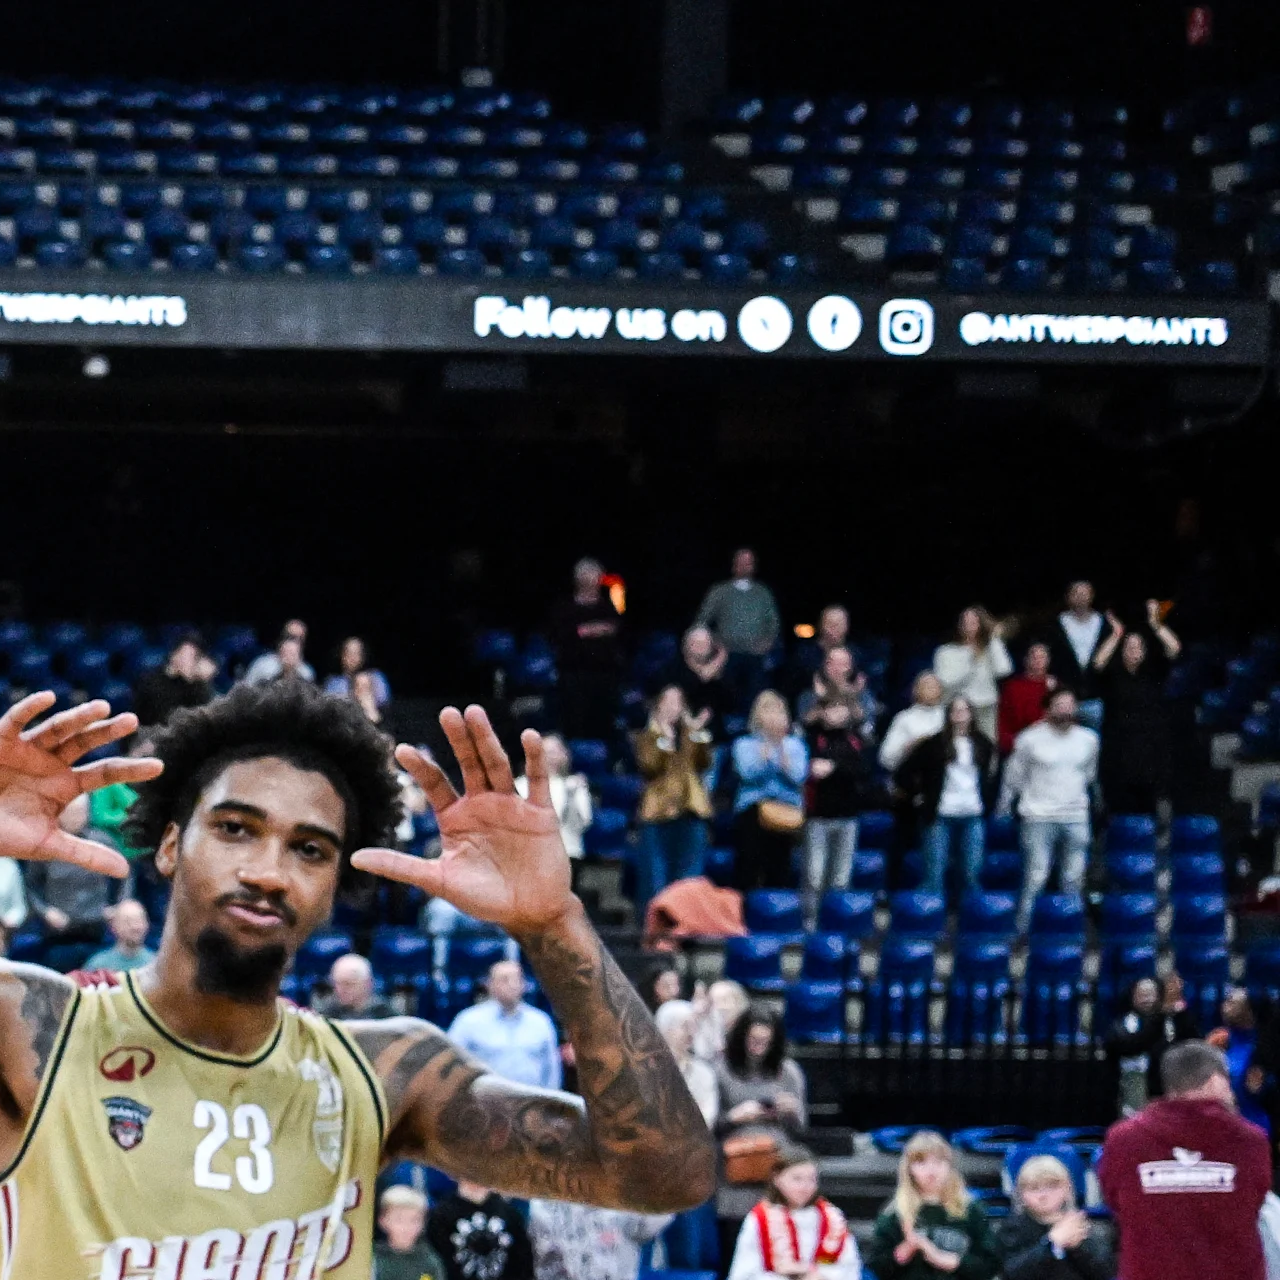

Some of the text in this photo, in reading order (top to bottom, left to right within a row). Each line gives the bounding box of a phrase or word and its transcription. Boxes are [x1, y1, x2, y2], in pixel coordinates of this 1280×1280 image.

[473, 294, 728, 343] Follow us on
[959, 311, 1229, 347] @ANTWERPGIANTS
[192, 1099, 275, 1195] 23
